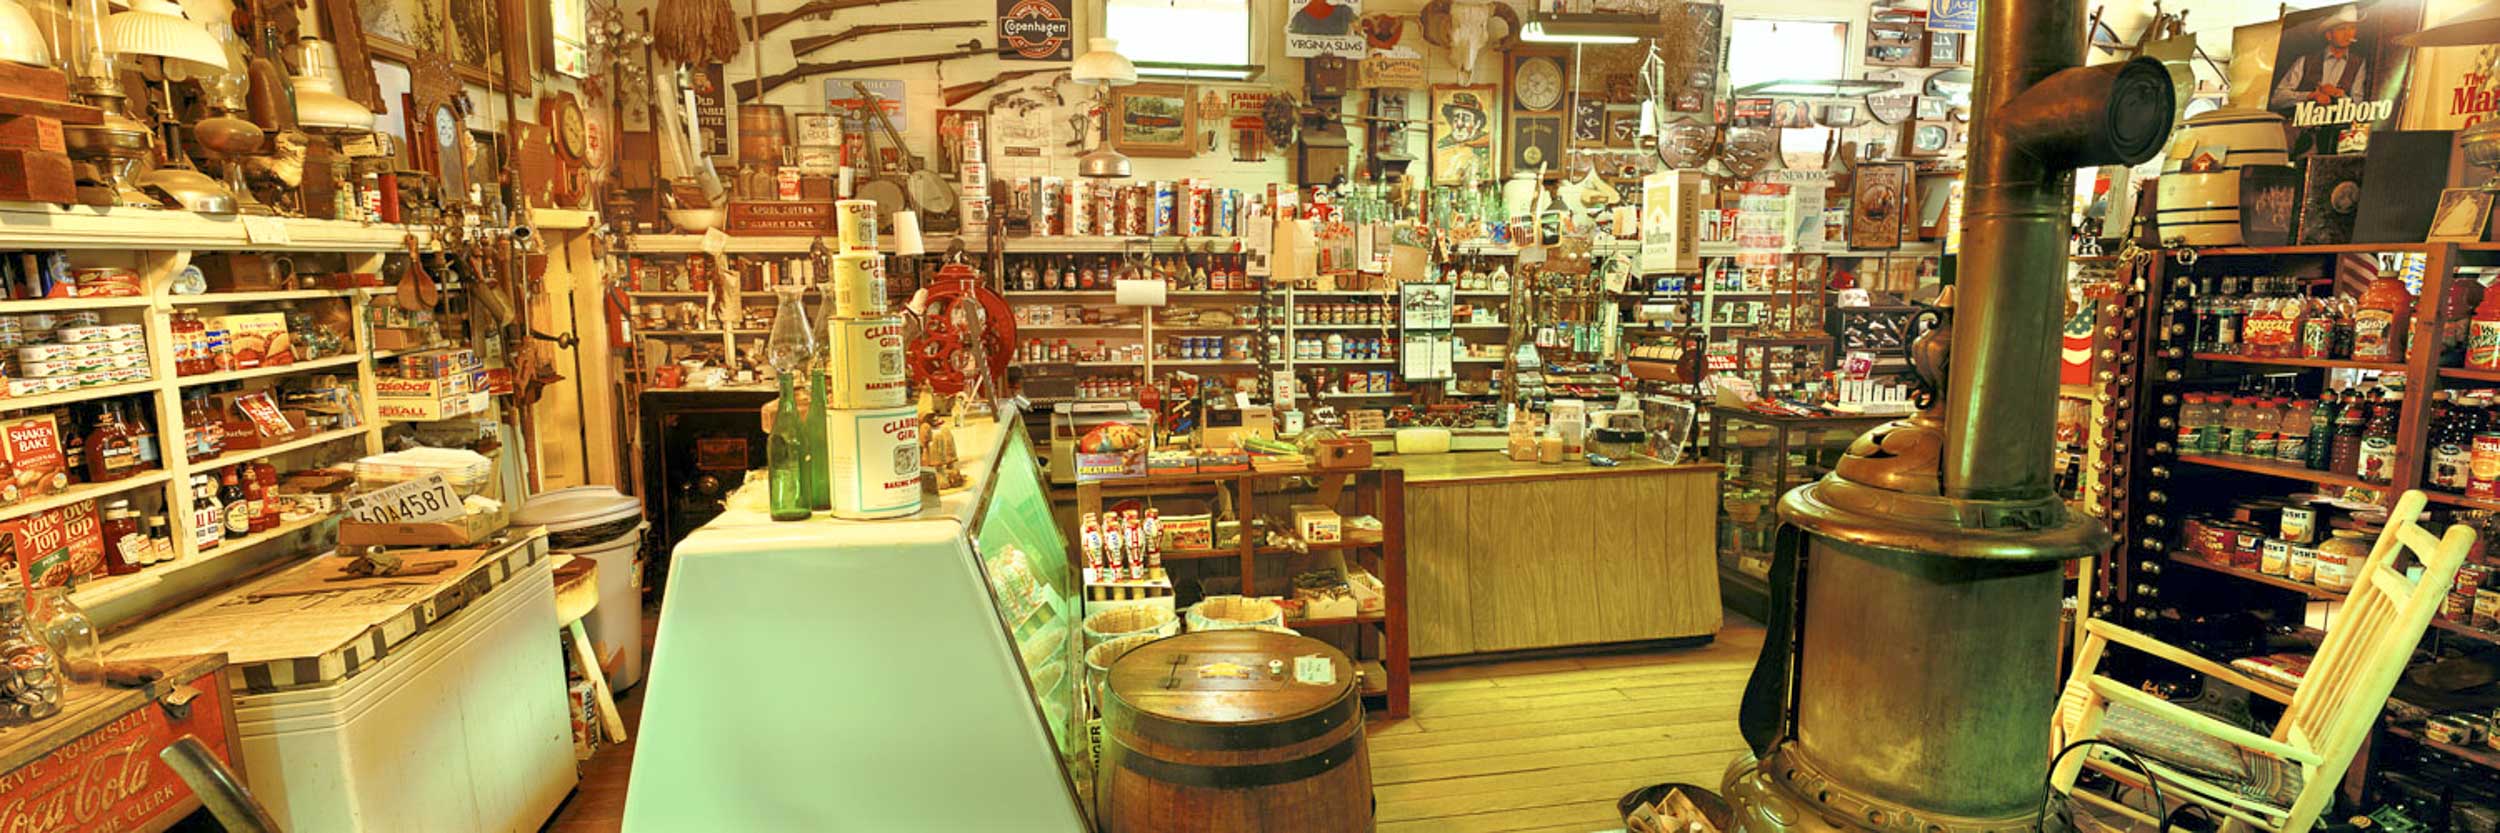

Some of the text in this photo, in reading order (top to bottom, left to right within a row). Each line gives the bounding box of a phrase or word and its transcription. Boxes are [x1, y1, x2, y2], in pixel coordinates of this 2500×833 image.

[1004, 19, 1068, 38] Copenhagen
[1291, 39, 1363, 52] VIRGINIA SLIMS
[2463, 73, 2487, 87] The
[1239, 101, 1267, 110] PRID
[2292, 97, 2393, 128] Marlboro
[376, 381, 431, 392] aseball
[883, 417, 918, 434] CLABB
[19, 438, 49, 453] BAKE
[19, 499, 96, 549] Stove ove
[33, 517, 94, 554] Top Top
[53, 707, 149, 765] YOURSELF
[0, 760, 43, 794] RVE
[127, 784, 175, 823] CLERK
